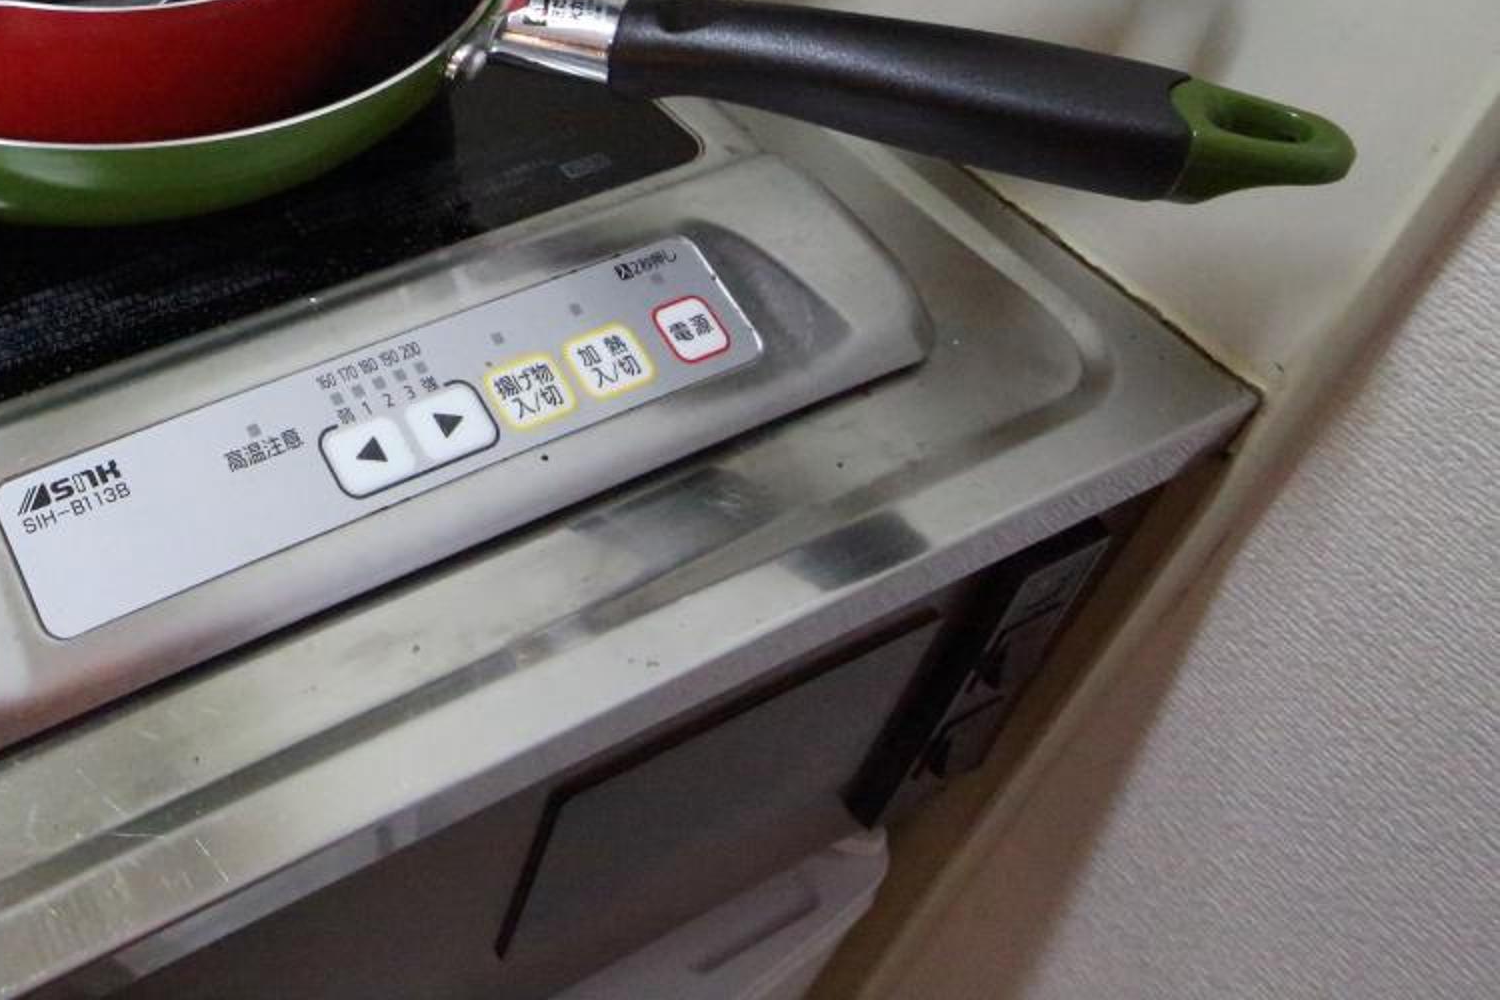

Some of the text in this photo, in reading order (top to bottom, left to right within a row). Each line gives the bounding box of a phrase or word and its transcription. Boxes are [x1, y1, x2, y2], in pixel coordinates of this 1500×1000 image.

[669, 314, 713, 341] 電源
[316, 373, 337, 390] 160
[337, 364, 359, 384] 170
[398, 341, 421, 360] 200
[495, 364, 554, 400] 揚げ物
[361, 401, 372, 416] 1
[383, 393, 395, 409] 2
[403, 385, 415, 401] 3
[23, 483, 131, 534] SIH-B113B
